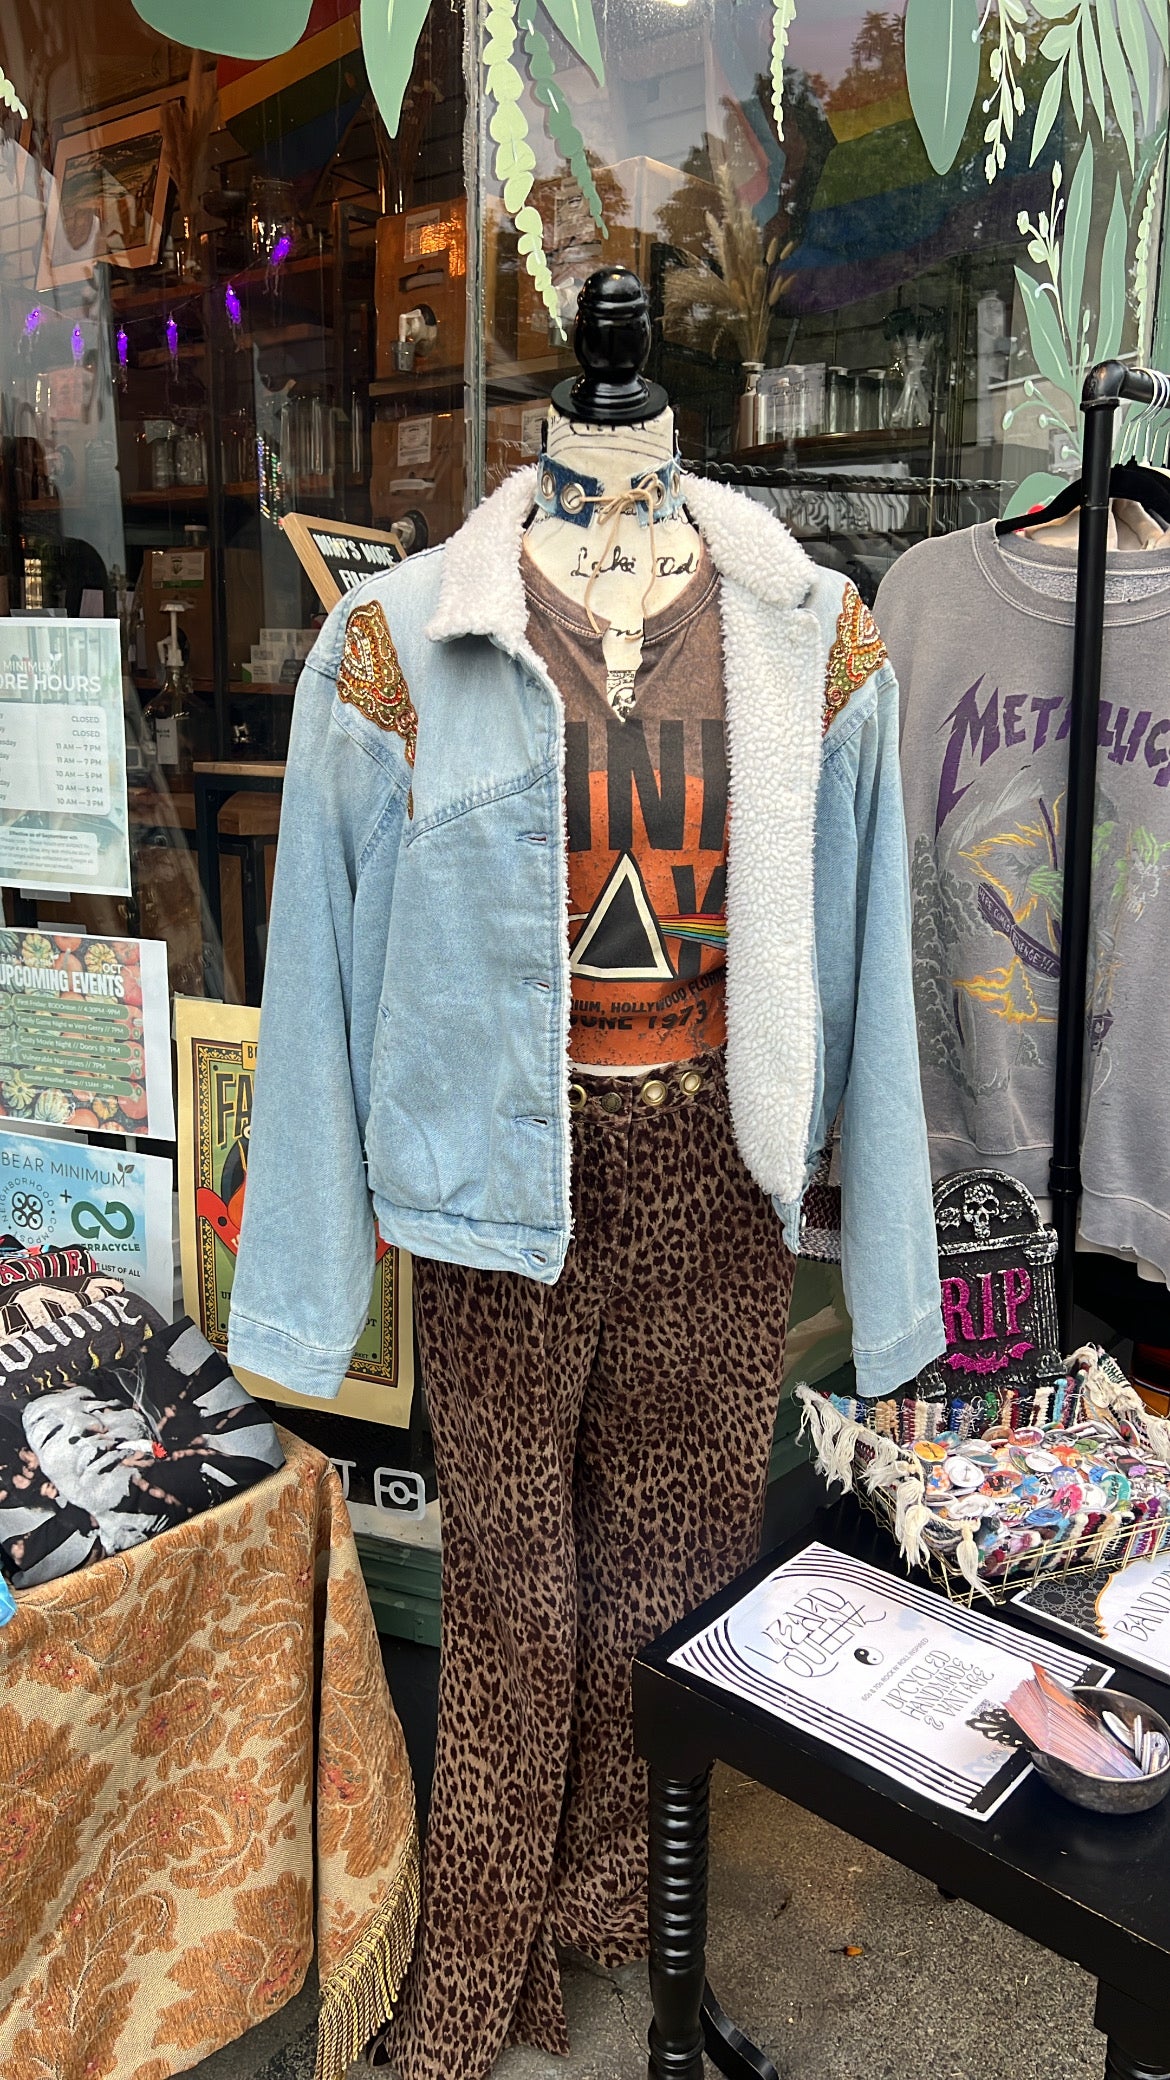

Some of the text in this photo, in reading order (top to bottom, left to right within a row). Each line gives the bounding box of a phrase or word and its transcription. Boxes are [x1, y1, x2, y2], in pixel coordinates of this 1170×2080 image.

[3, 659, 57, 672] MINIMUM
[34, 674, 102, 692] HOURS
[71, 715, 100, 724] CLOSED
[72, 729, 101, 738] CLOSED
[90, 744, 101, 752] PM
[90, 758, 102, 766] PM
[935, 673, 1170, 846] METLLIC
[64, 770, 76, 778] AM
[90, 772, 102, 780] PM
[66, 784, 77, 792] AM
[92, 786, 103, 794] PM
[66, 798, 78, 806] AM
[102, 963, 122, 974] OCT
[0, 963, 69, 993] UPCOMING
[72, 970, 125, 998] EVENTS
[611, 987, 687, 1013] HOLLYWOOD
[648, 1000, 708, 1029] 1973
[1, 1151, 126, 1188] BEAR MINIMUM
[0, 1177, 54, 1223] NEIGHBORHOOD
[80, 1243, 141, 1252] RRACYCLE
[101, 1263, 116, 1273] LIST
[128, 1269, 141, 1278] ALL
[940, 1267, 1033, 1346] RIP
[1112, 1591, 1170, 1642] BAND
[881, 1668, 896, 1685] ROCK
[899, 1653, 911, 1668] ROLL
[908, 1637, 929, 1657] INSPIRED
[881, 1650, 951, 1710] UPCYCLED
[900, 1657, 974, 1721] HANDMADE
[933, 1666, 995, 1717] VINTAGE
